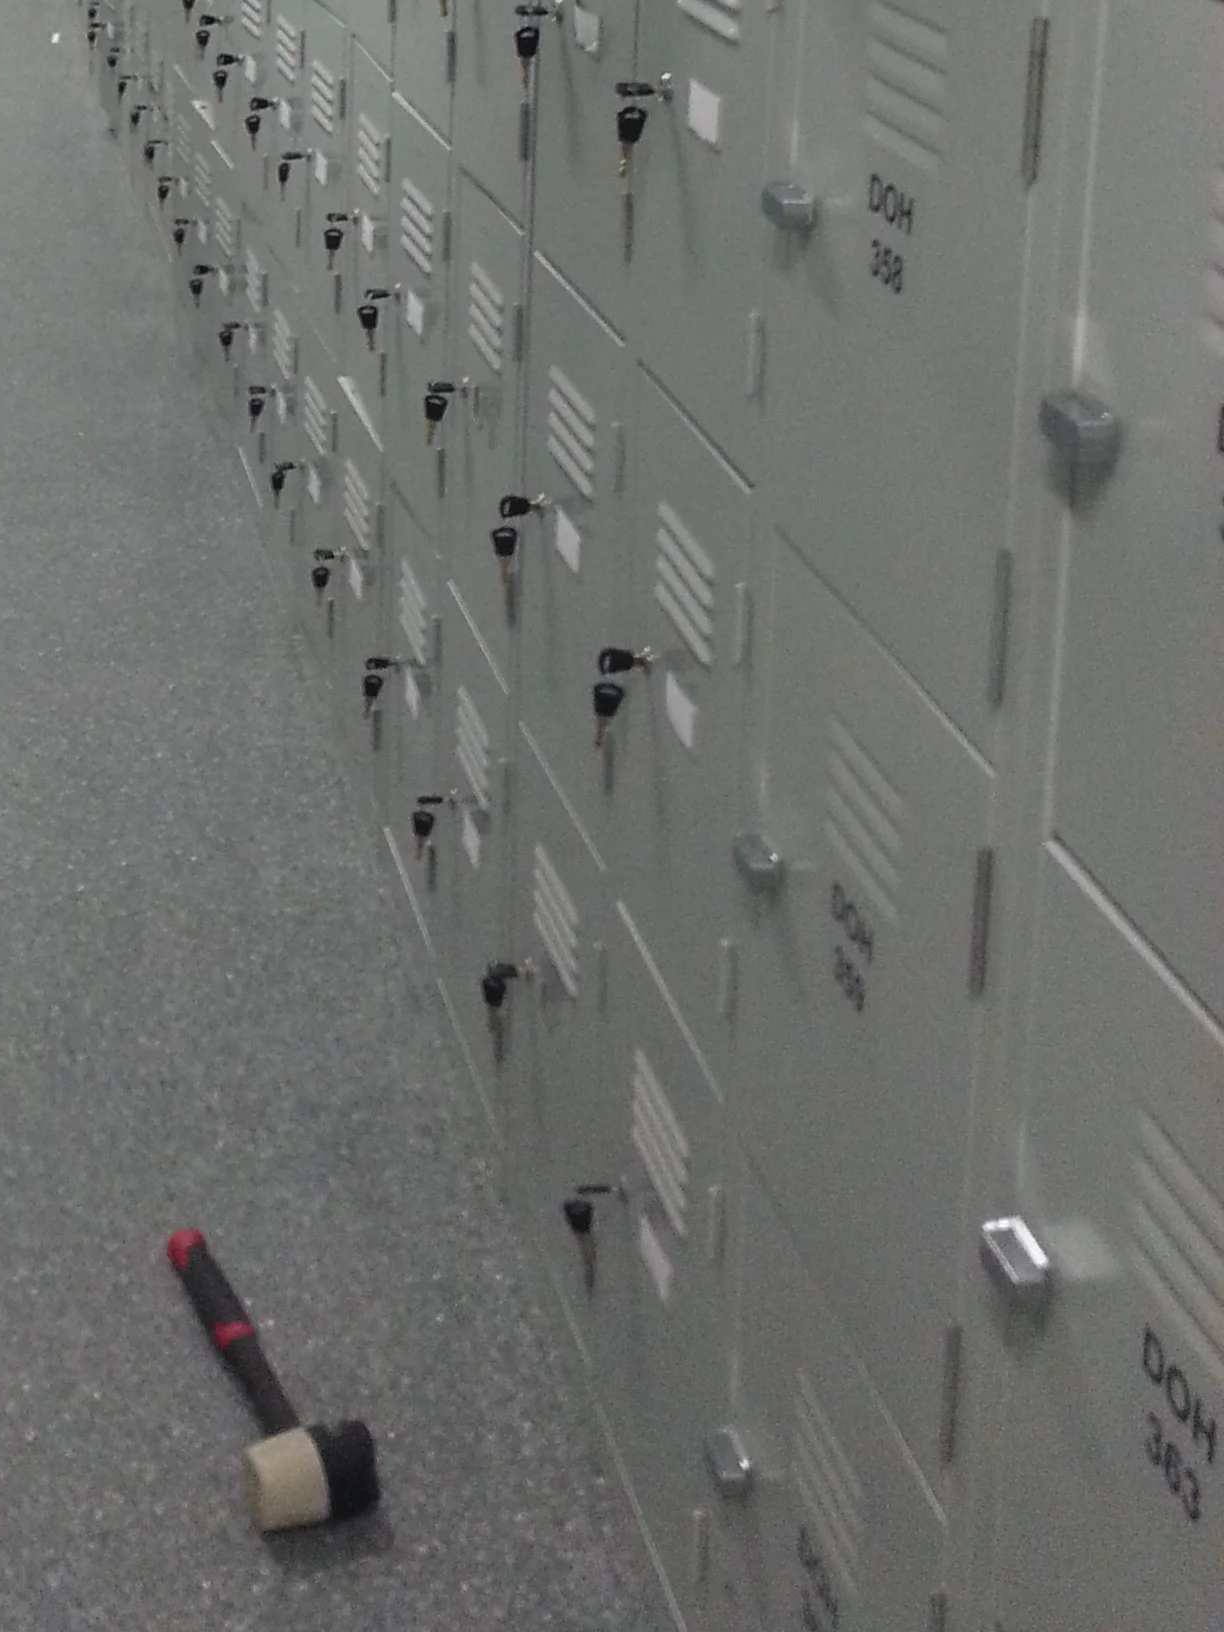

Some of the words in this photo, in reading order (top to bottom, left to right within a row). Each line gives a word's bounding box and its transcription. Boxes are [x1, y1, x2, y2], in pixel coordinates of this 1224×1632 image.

[869, 174, 914, 235] DOH
[870, 239, 904, 294] 358
[1143, 1321, 1217, 1464] DOH
[1145, 1410, 1202, 1522] 363
